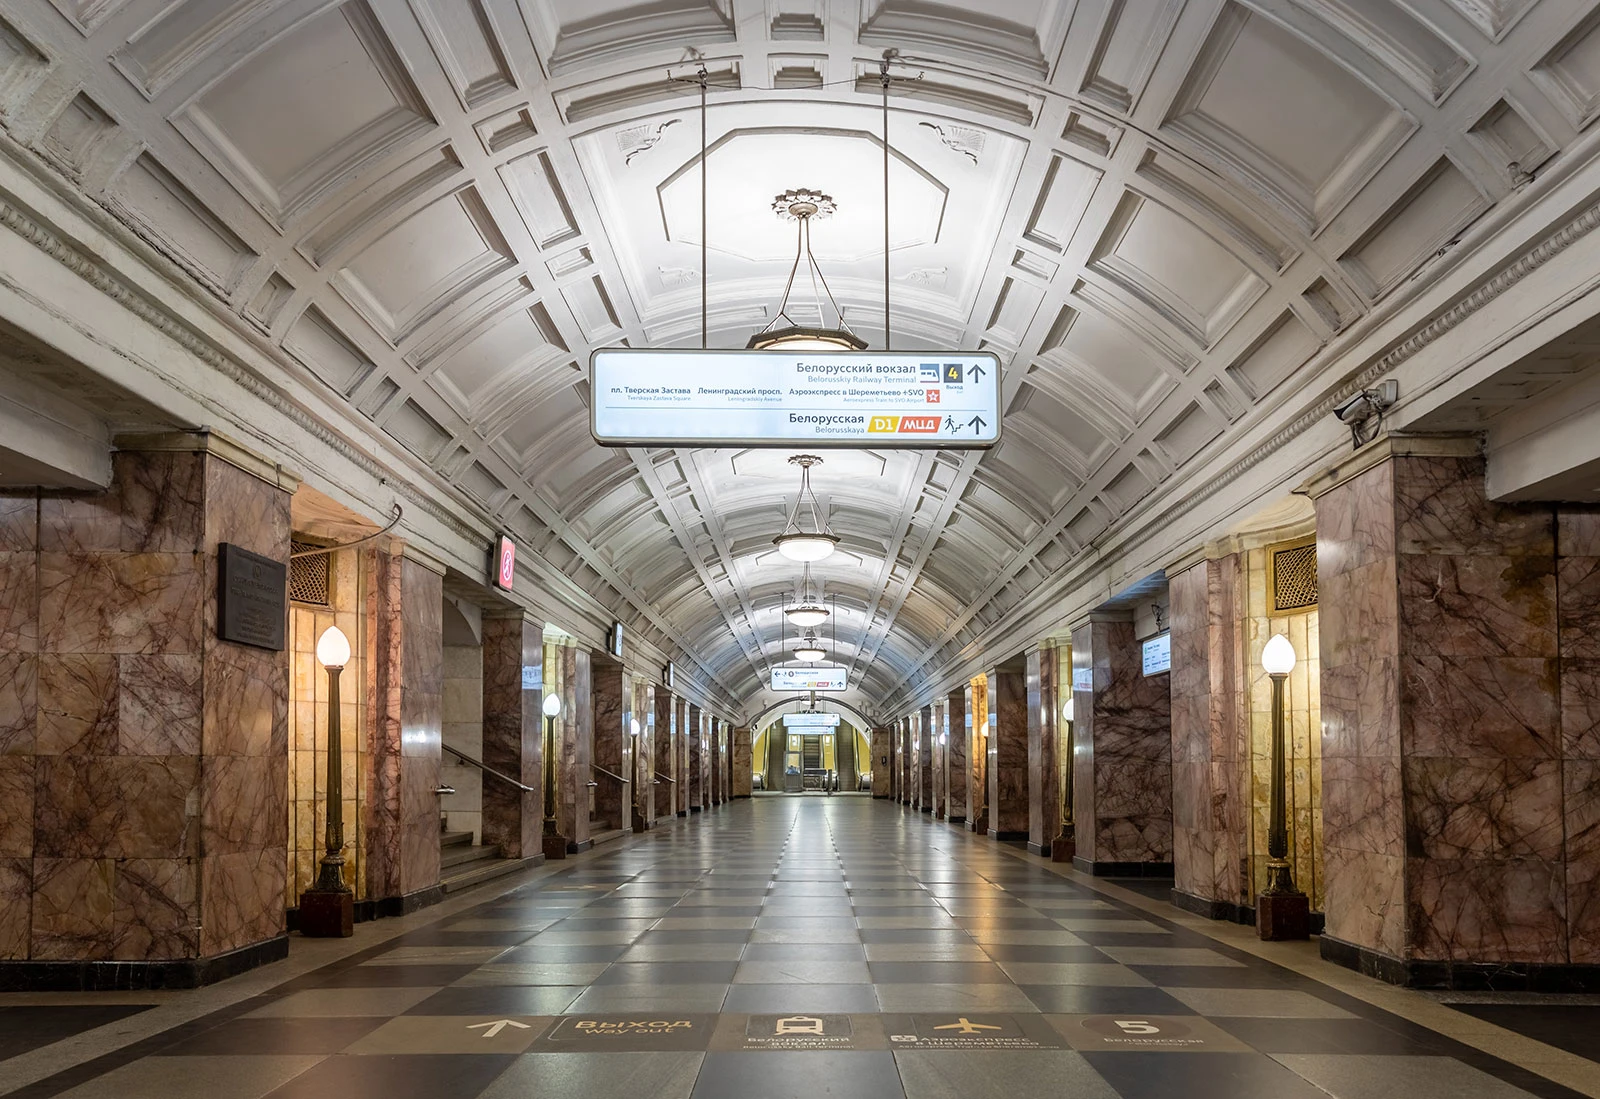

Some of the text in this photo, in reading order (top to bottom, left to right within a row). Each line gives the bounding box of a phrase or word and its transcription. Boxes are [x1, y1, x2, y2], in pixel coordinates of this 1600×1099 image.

[796, 362, 916, 375] Белорусский вокзал
[948, 367, 959, 380] 4
[807, 375, 917, 385] Belorusskiy Railway Terminal
[624, 386, 660, 396] Тверская
[661, 387, 691, 395] Застава
[697, 387, 783, 396] Ленинградский просп.
[789, 388, 841, 397] Аэроэкспресс
[848, 388, 902, 397] Шереметьево
[789, 413, 864, 425] Белорусская
[874, 418, 894, 430] D1
[903, 418, 936, 430] МЦД
[815, 426, 865, 435] Belorusskaya
[1114, 1020, 1160, 1034] 5
